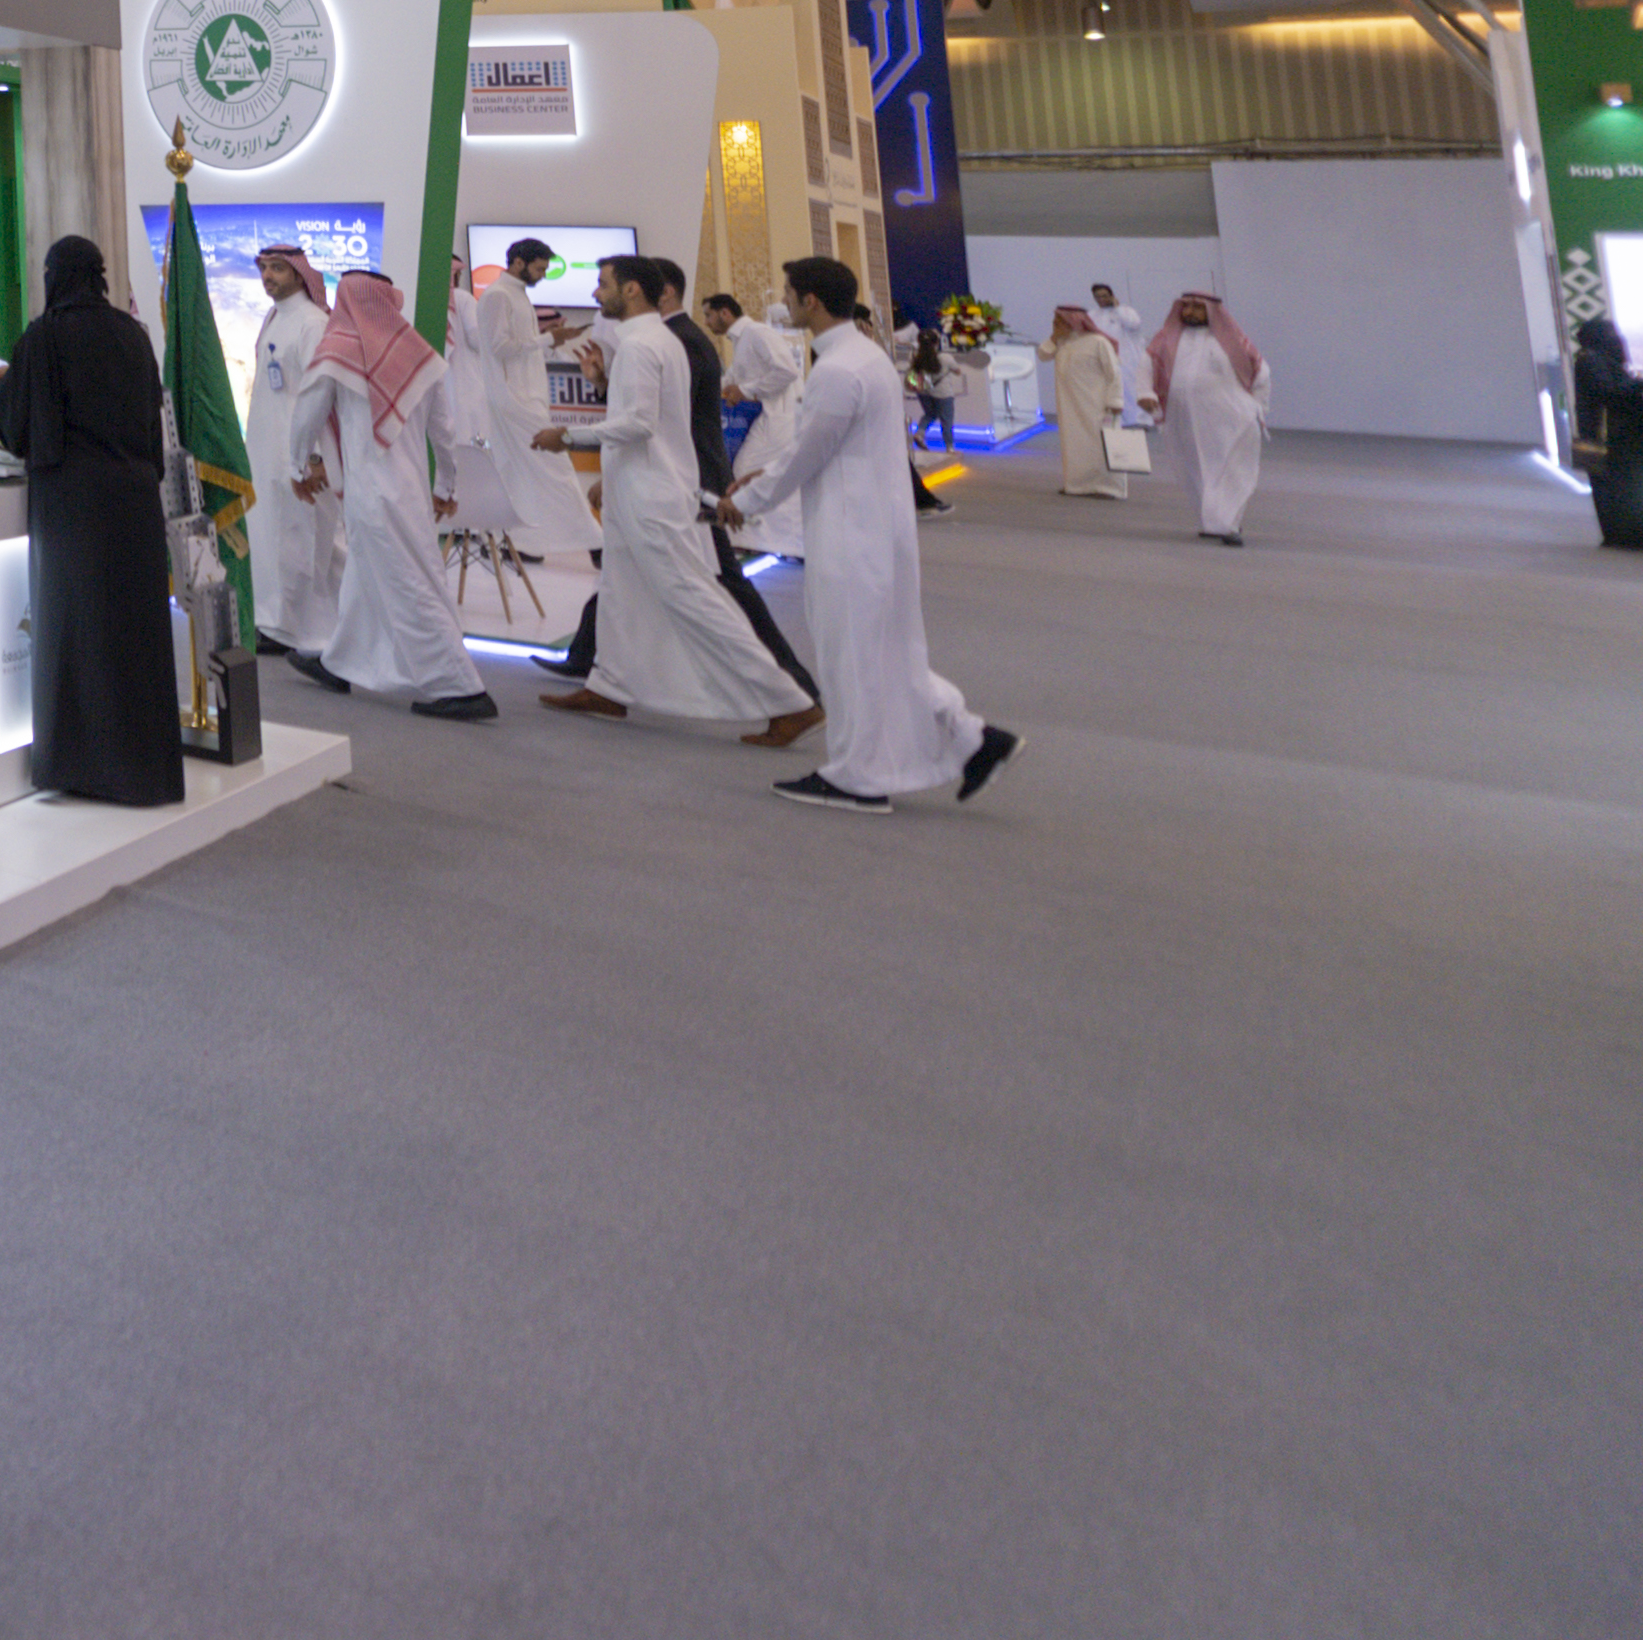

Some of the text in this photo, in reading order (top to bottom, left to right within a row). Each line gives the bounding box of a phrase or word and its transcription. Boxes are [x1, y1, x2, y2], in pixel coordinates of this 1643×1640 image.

[472, 95, 503, 104] العامة
[537, 95, 569, 104] معهد
[473, 105, 569, 114] BUSINESS CENTER
[1569, 165, 1614, 180] King
[296, 220, 330, 232] VISION
[333, 218, 367, 234] رؤية
